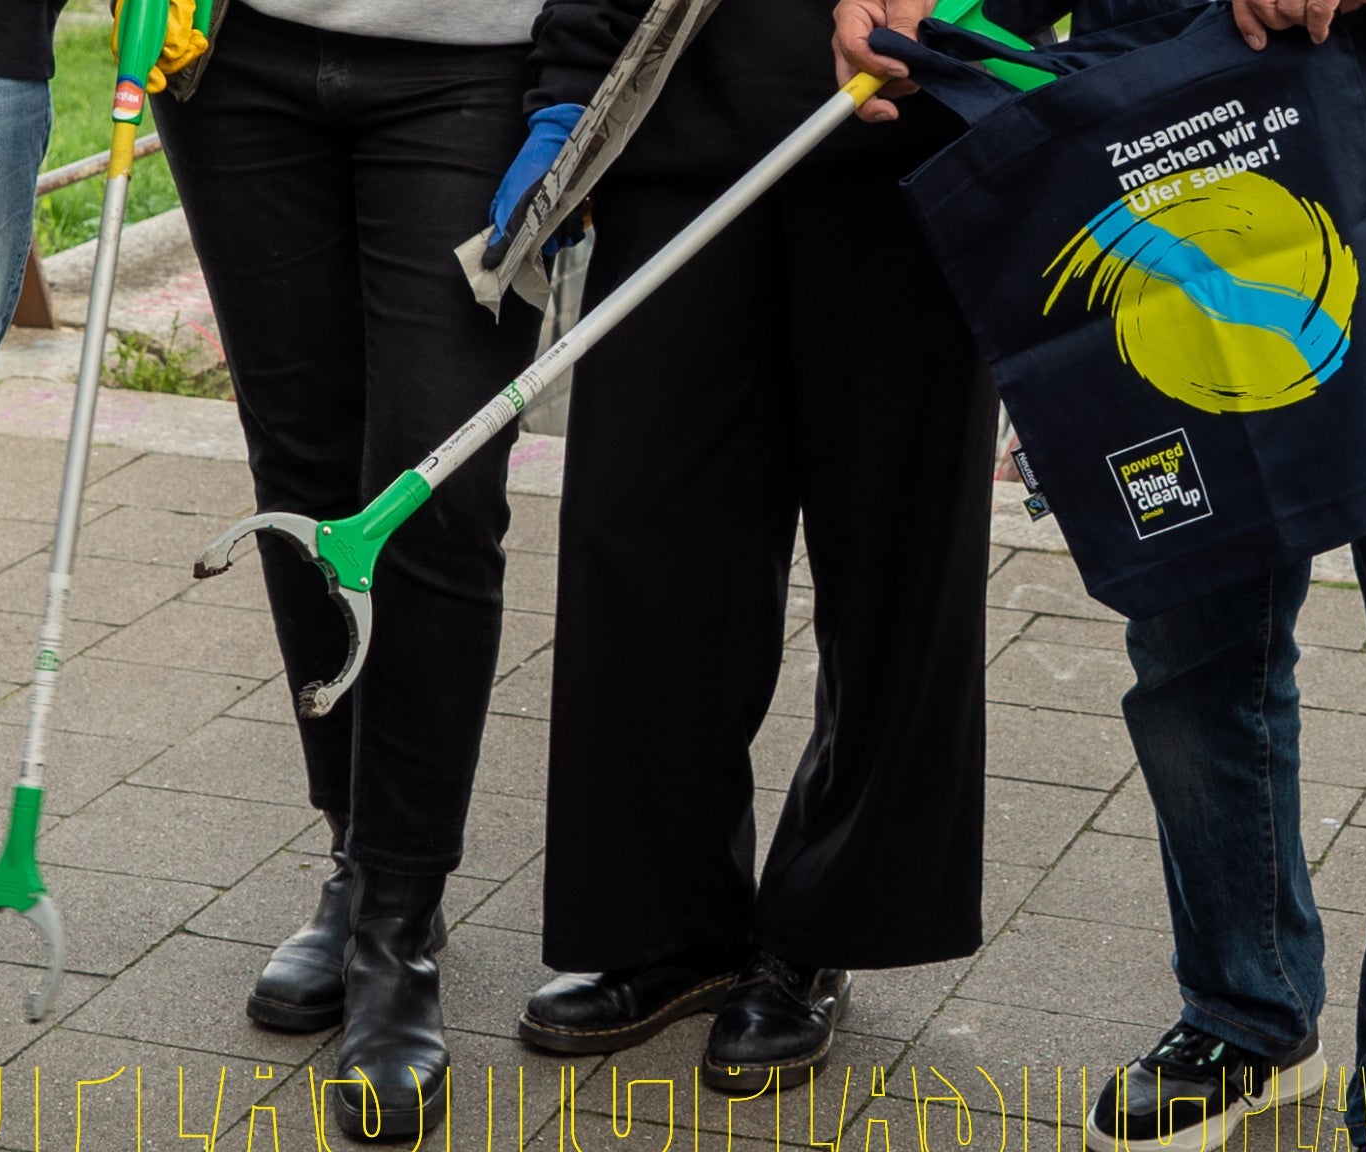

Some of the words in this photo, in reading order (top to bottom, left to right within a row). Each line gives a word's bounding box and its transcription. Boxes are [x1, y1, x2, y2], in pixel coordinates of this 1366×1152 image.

[1106, 99, 1245, 167] Zusammen
[1119, 139, 1216, 191] machen
[1218, 120, 1257, 148] wir
[1263, 106, 1300, 134] die
[1130, 179, 1182, 212] Ufer
[1190, 138, 1281, 188] sauber!
[1120, 442, 1184, 483] powered
[1161, 456, 1180, 474] by
[1127, 472, 1177, 499] Rhine
[1138, 485, 1182, 510] clean
[1179, 488, 1201, 508] up
